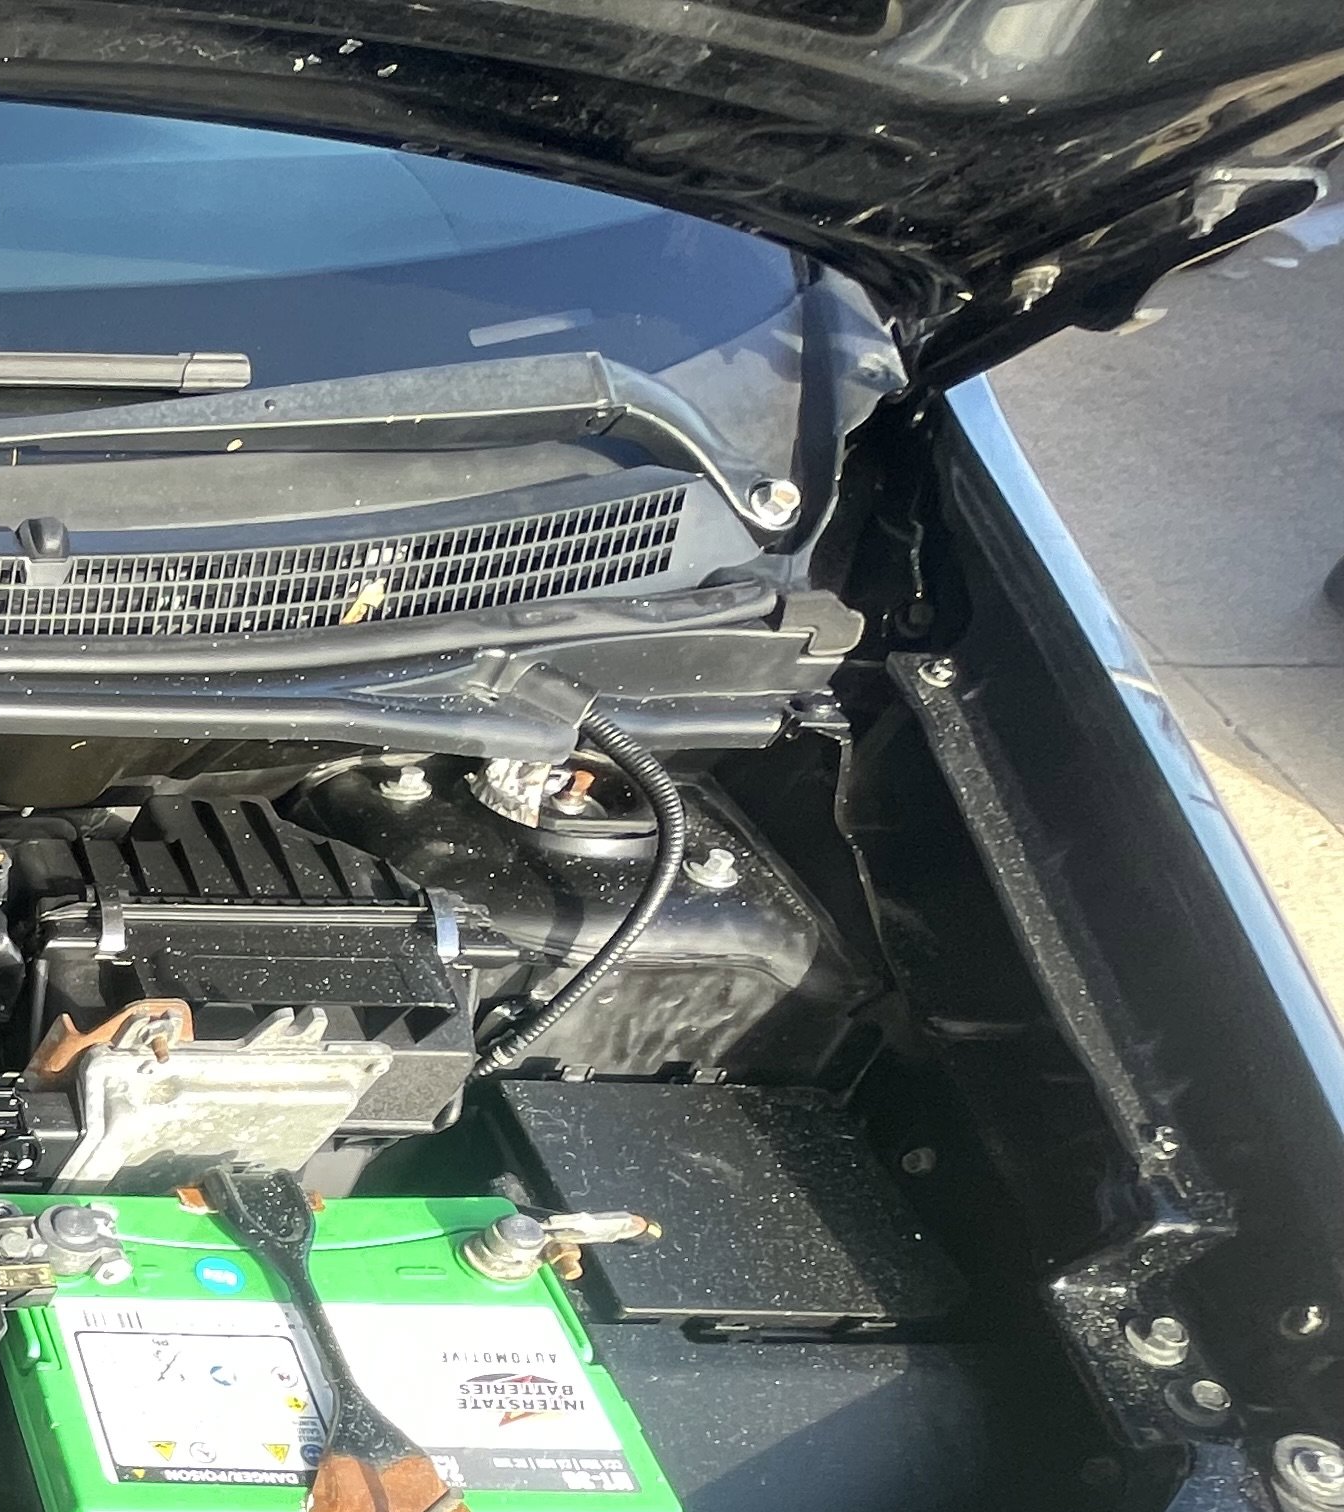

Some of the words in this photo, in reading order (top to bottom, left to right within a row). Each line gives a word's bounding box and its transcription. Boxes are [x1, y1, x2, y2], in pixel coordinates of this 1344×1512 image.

[442, 1351, 557, 1364] AUTOMOTIVE
[459, 1384, 574, 1396] BATTERIES
[457, 1398, 585, 1411] INTERSTATE
